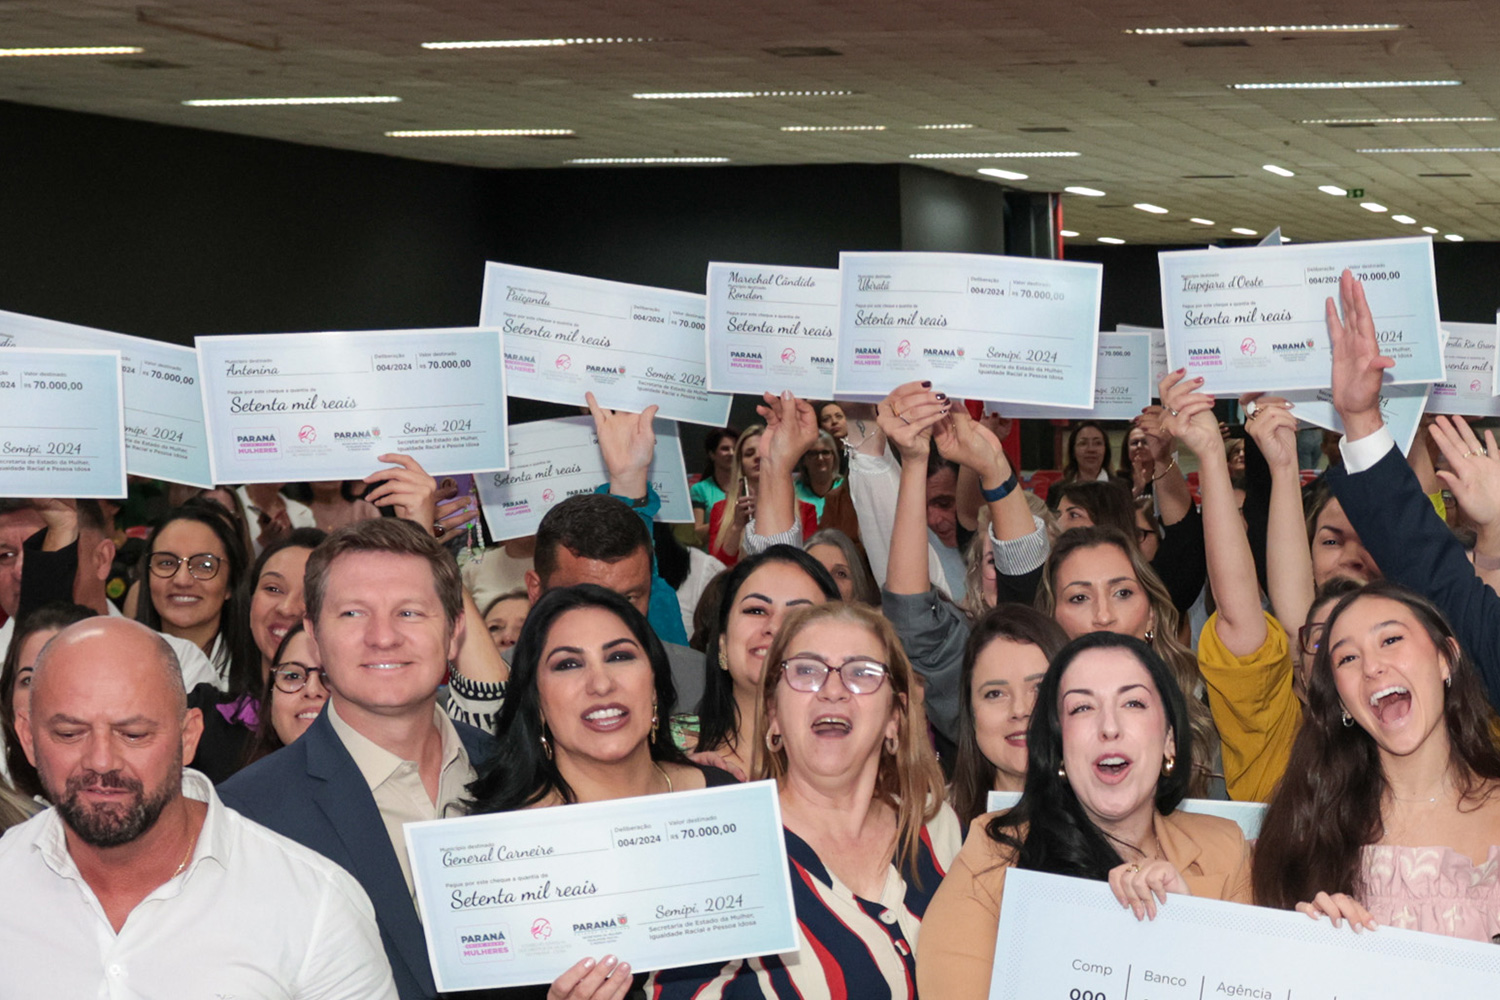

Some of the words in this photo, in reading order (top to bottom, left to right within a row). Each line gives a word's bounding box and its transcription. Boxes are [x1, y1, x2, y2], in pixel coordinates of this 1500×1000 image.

[728, 271, 773, 285] Marechal
[775, 274, 815, 288] Cândido
[1357, 271, 1400, 281] 70.000,00
[970, 287, 1005, 296] 004/2024
[1182, 278, 1225, 293] Itapejara
[728, 288, 763, 300] Rondon
[1020, 289, 1065, 301] 70.000,00
[633, 314, 665, 323] 004/2024
[855, 310, 896, 327] Setenta
[897, 311, 917, 325] mil
[919, 315, 948, 327] reais
[1184, 309, 1230, 327] Setenta
[1234, 307, 1257, 323] mil
[1260, 309, 1292, 322] reais
[502, 317, 552, 339] Setenta
[555, 329, 578, 342] mil
[581, 333, 611, 348] reais
[727, 316, 775, 334] Setenta
[778, 321, 801, 335] mil
[803, 325, 832, 337] reais
[1025, 349, 1058, 363] 2024
[226, 364, 279, 377] Antonina
[376, 363, 412, 372] 004/2024
[428, 359, 471, 370] 70.000,00
[151, 370, 195, 385] 70.000,00
[681, 373, 706, 386] 2024
[34, 380, 83, 391] 70.000,00
[230, 396, 288, 414] Setenta
[292, 394, 318, 411] mil
[322, 396, 358, 410] reais
[442, 419, 472, 432] 2024
[46, 442, 81, 454] 2024
[686, 815, 717, 824] destinado
[614, 823, 652, 833] Deliberação
[681, 823, 737, 839] 70.000,00
[617, 834, 661, 848] 004/2024
[442, 847, 495, 868] General
[497, 845, 554, 861] Carneiro
[451, 888, 517, 909] Setenta
[521, 880, 551, 901] mil
[555, 880, 599, 897] reais
[704, 894, 743, 912] 2024
[572, 918, 616, 931] PARANÁ
[461, 931, 506, 944] PARANÁ
[463, 946, 509, 957] MULHERES
[1072, 959, 1113, 976] Comp
[1144, 970, 1187, 987] Banco
[1216, 982, 1272, 1000] Agência
